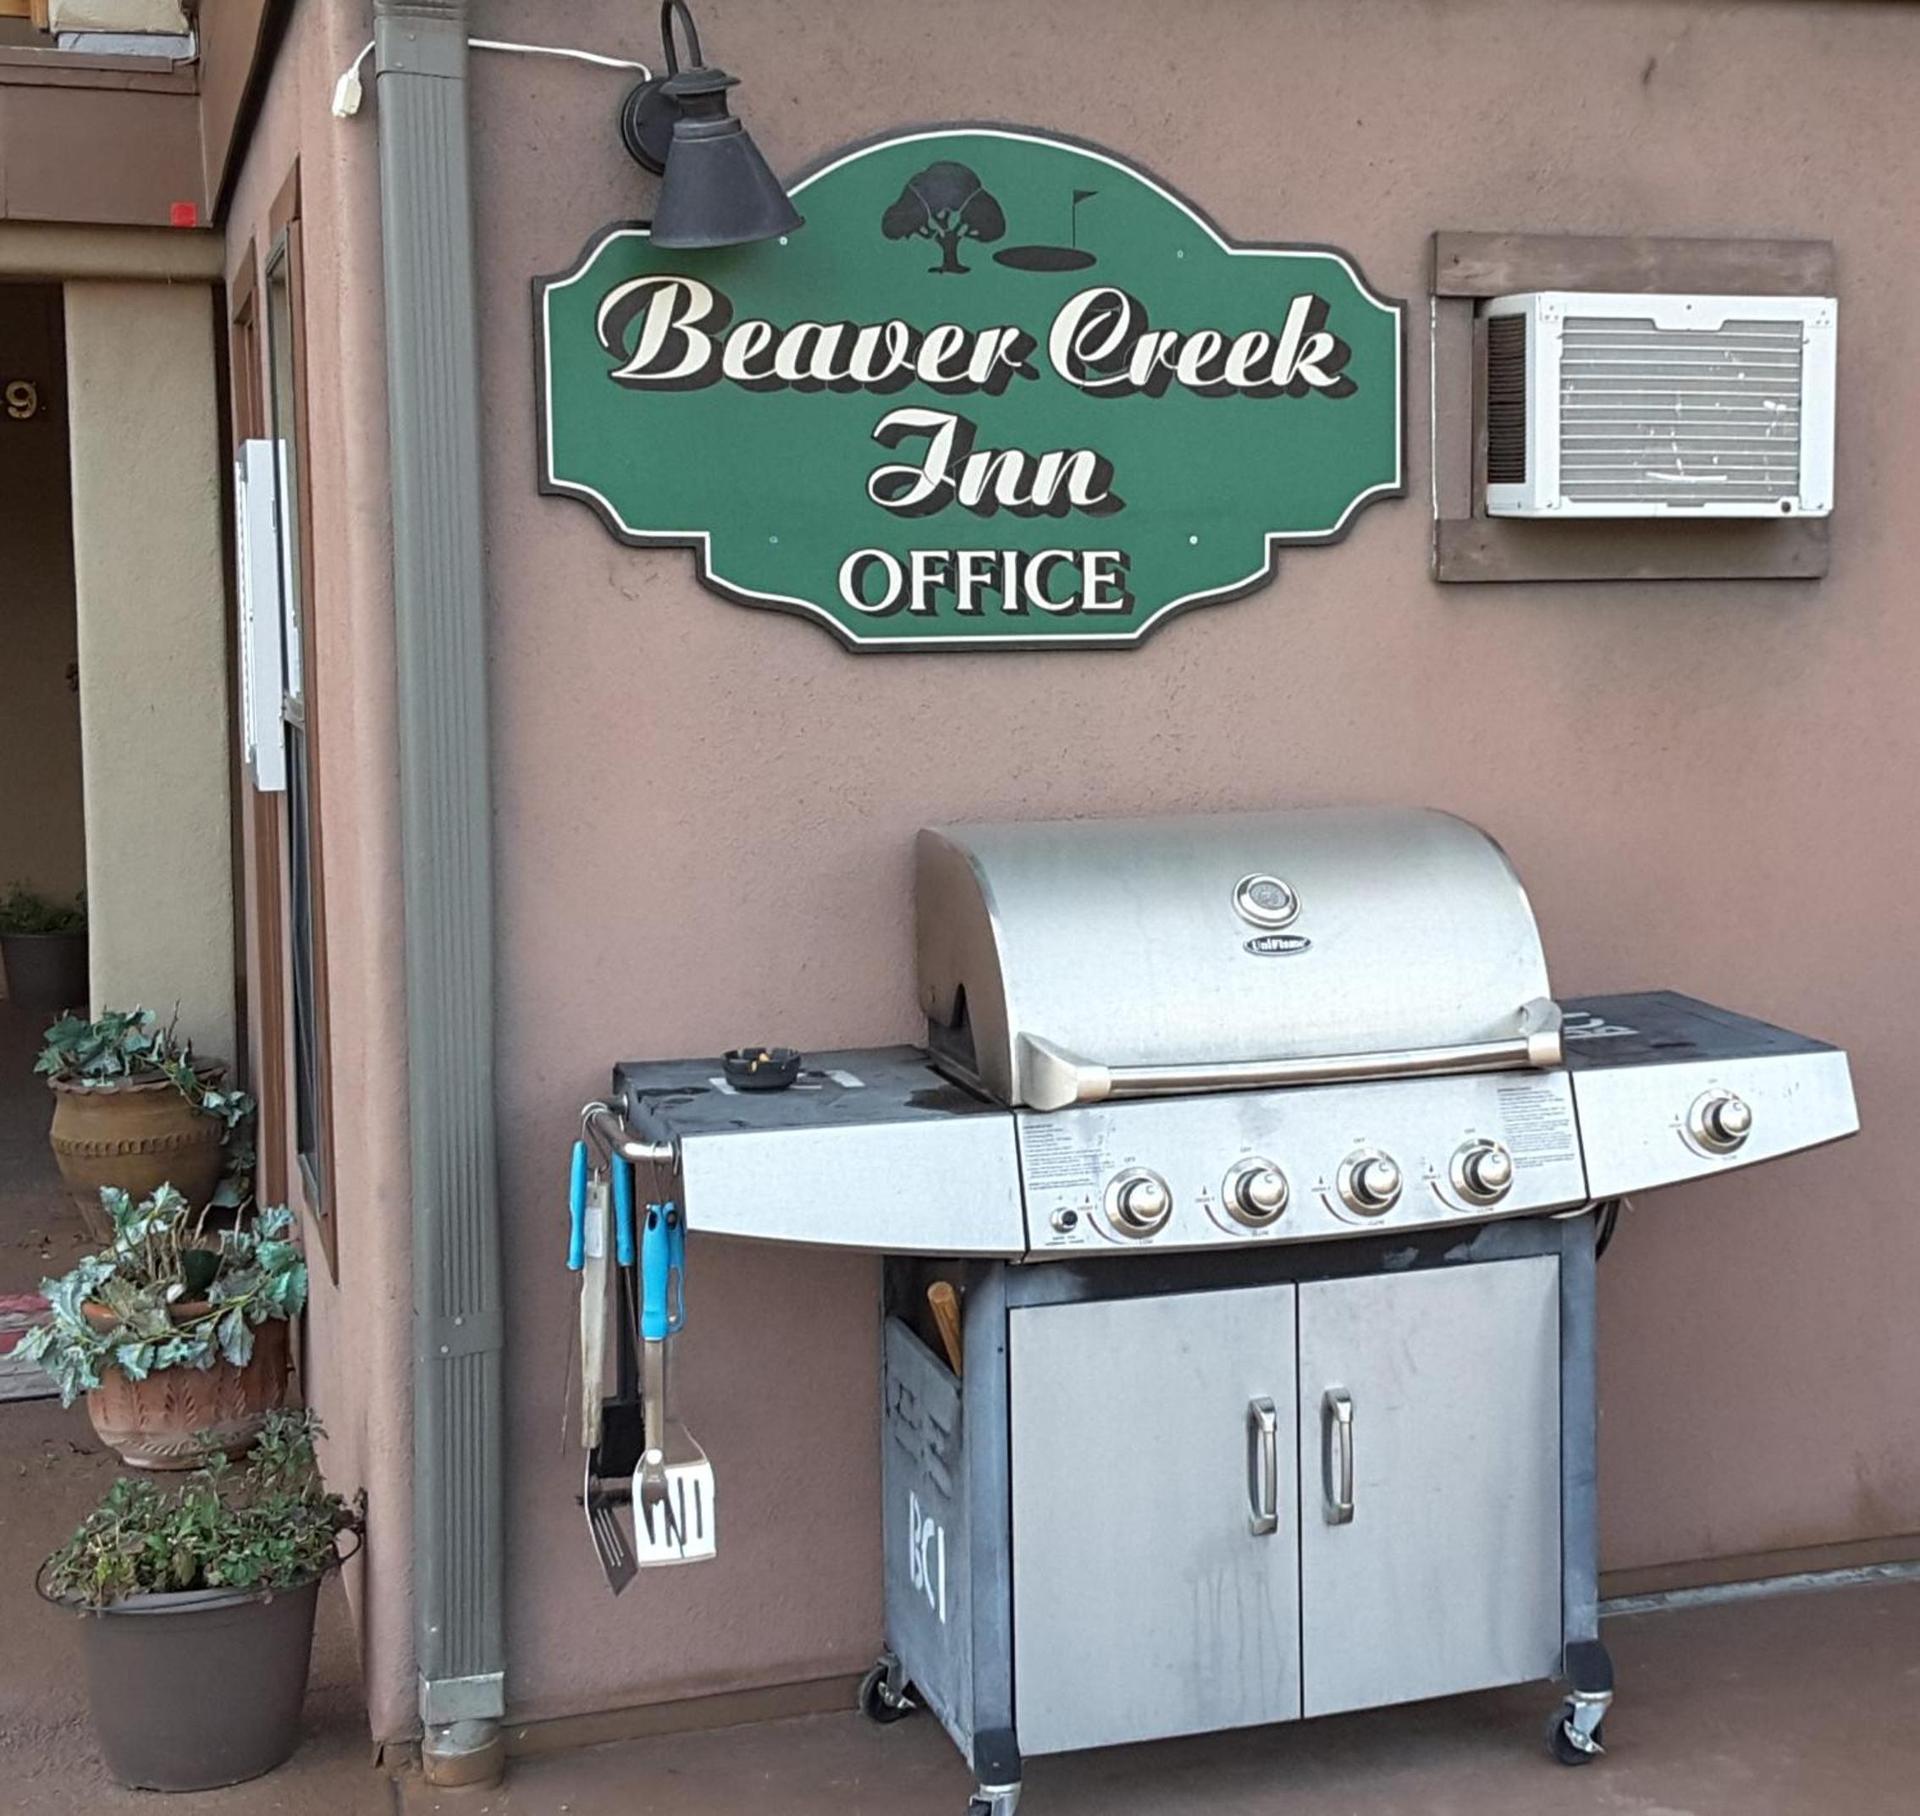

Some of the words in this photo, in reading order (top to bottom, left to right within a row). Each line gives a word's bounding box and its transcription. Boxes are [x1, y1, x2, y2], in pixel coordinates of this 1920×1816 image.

[595, 274, 1027, 388] Beaver
[1048, 285, 1346, 392] Creek
[5, 380, 37, 419] 9
[866, 406, 1117, 512] Inn
[837, 547, 1130, 615] OFFICE
[908, 1489, 947, 1625] BCI
